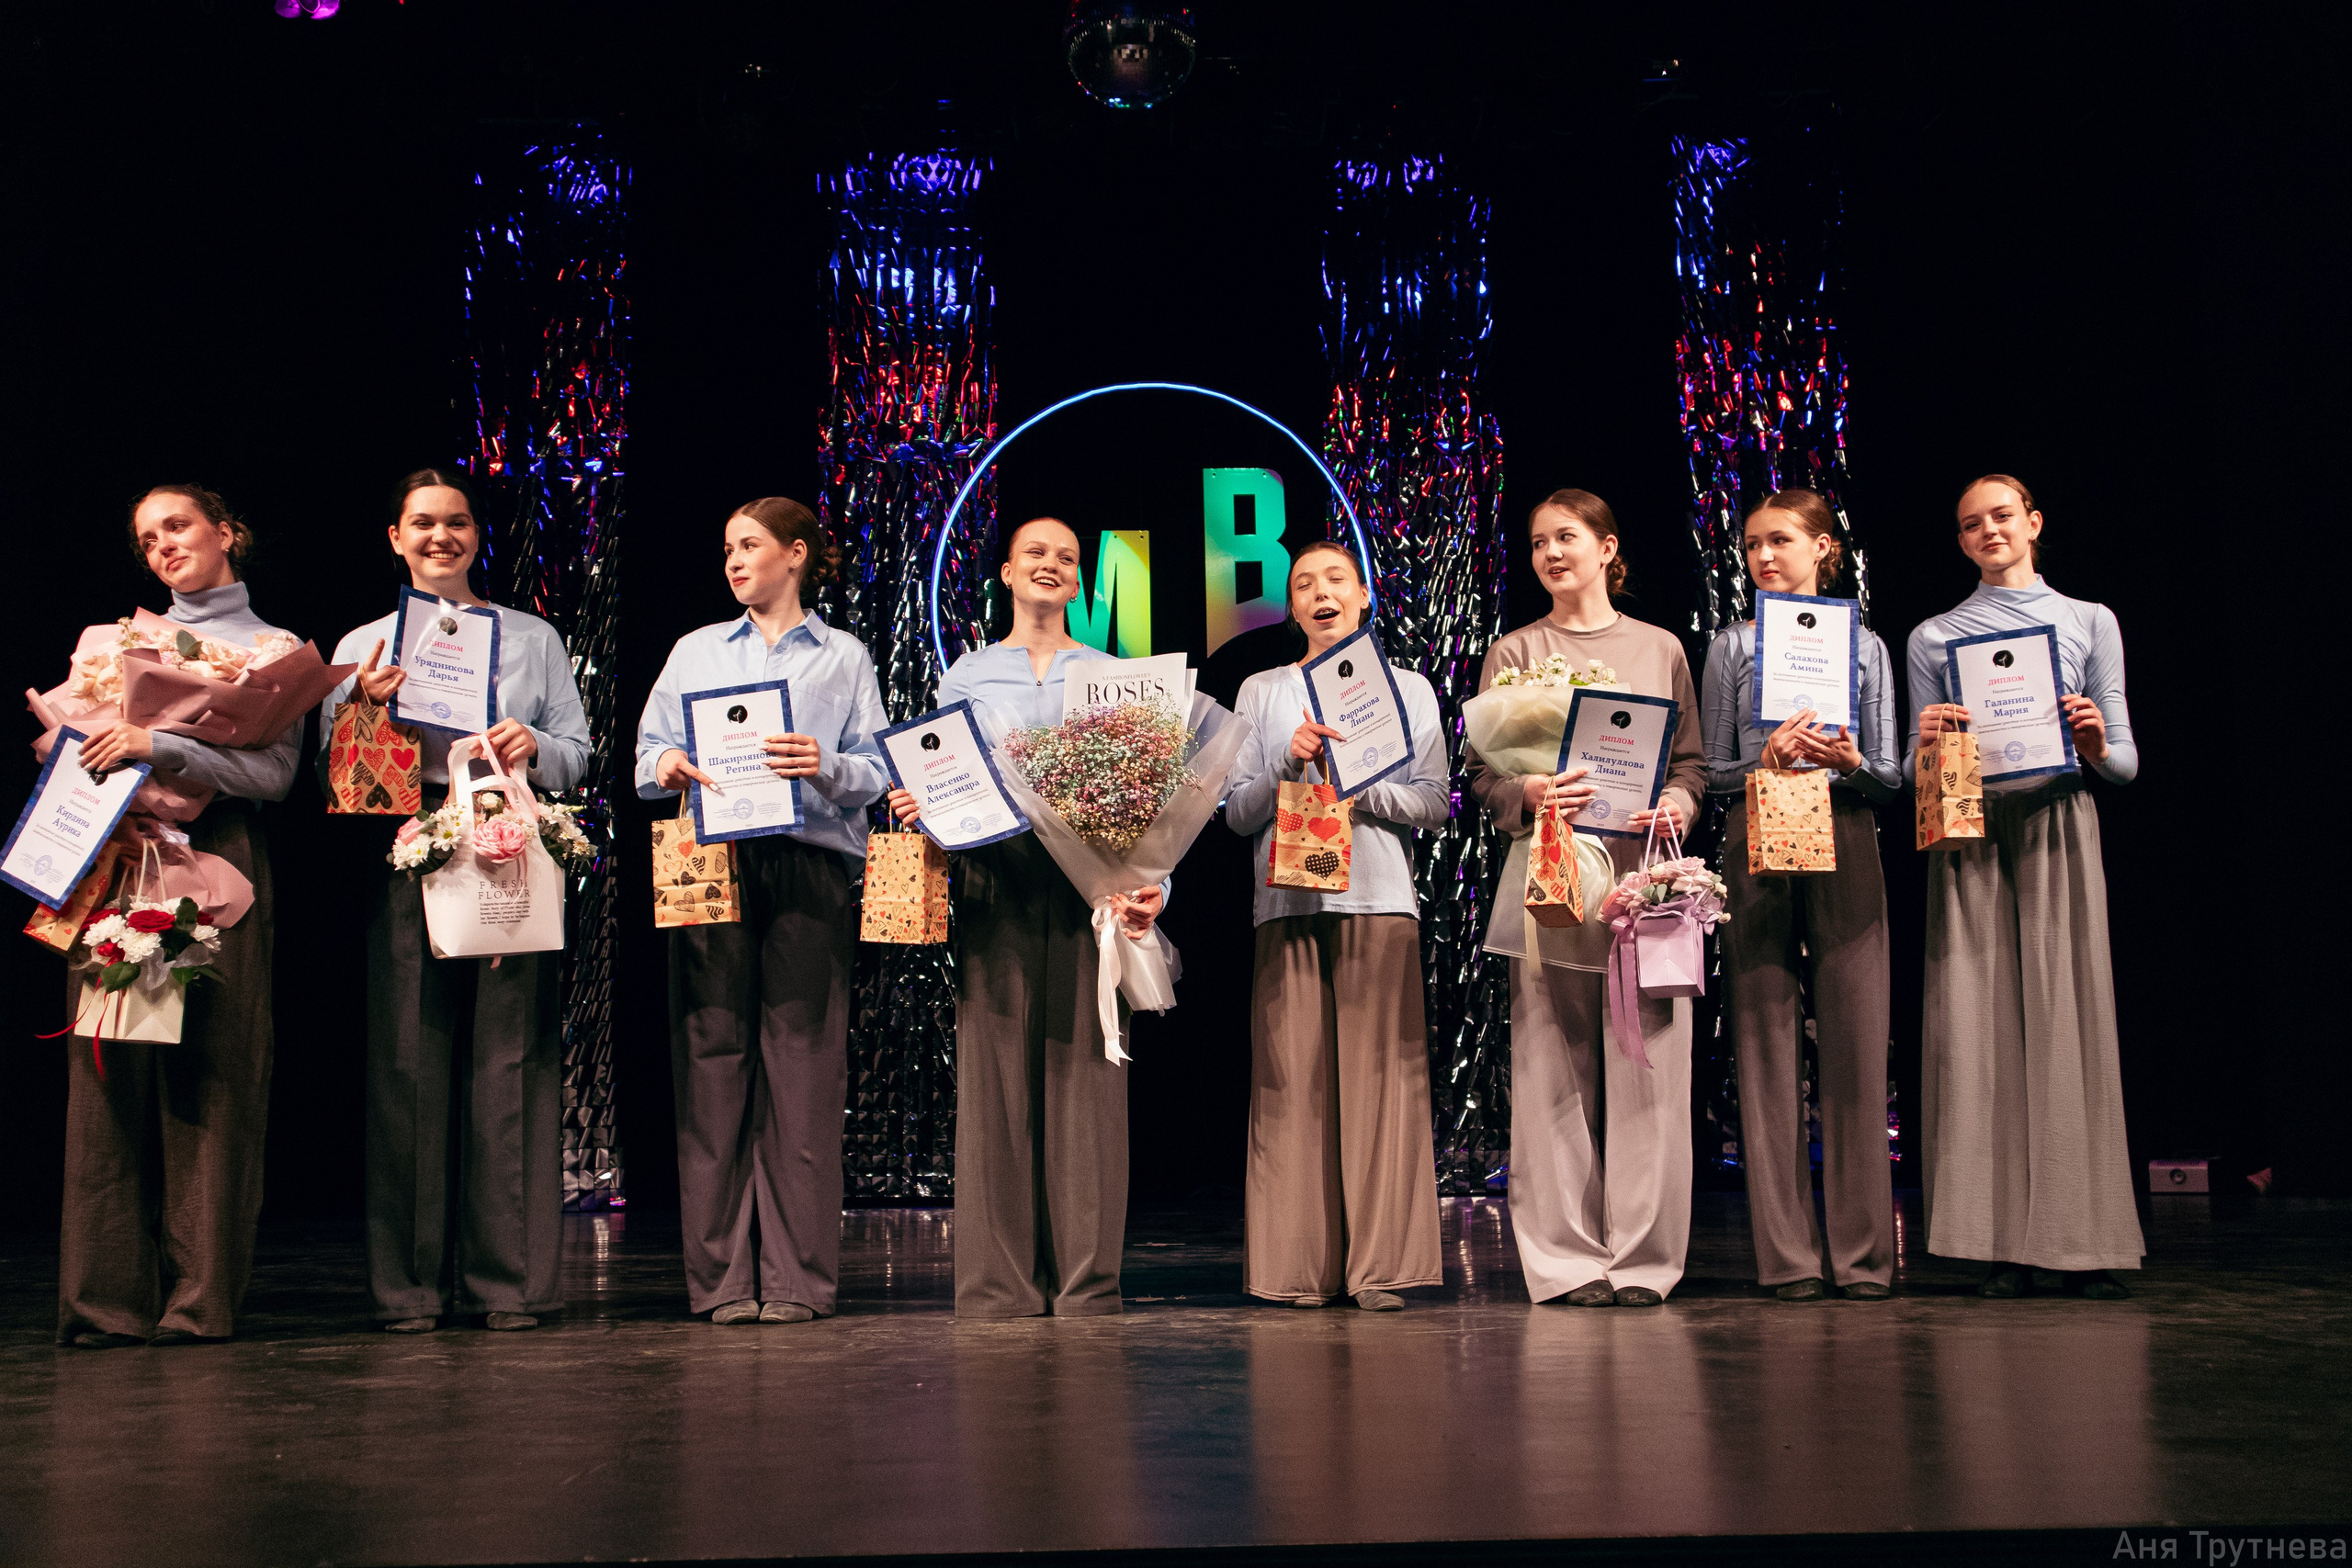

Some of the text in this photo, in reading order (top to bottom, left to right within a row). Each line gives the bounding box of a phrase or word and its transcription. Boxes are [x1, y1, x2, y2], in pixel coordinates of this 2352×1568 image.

[430, 638, 464, 654] ИПЛОМ
[1789, 636, 1824, 644] ДИПЛОМ
[415, 655, 474, 675] Урядникова
[1784, 652, 1828, 664] Салахова
[428, 669, 458, 682] Дарья
[1790, 662, 1823, 673] Амина
[1988, 675, 2025, 686] ДИПЛОМ
[1086, 678, 1166, 705] ROSES
[1340, 680, 1366, 700] ДИПЛОМ
[1339, 696, 1380, 722] Фаррахова
[1984, 696, 2035, 708] Галанина
[1351, 711, 1374, 728] Лиана
[1994, 707, 2029, 717] Мария
[722, 731, 758, 742] ДИПЛОМ
[1599, 735, 1634, 746] ДИПЛОМ
[708, 751, 777, 767] Шакирзянова
[923, 754, 956, 772] ДИПЛОМ
[1580, 751, 1645, 769] Халилуллова
[725, 764, 762, 774] Регина
[1595, 764, 1626, 776] Диана
[926, 773, 970, 794] Власенко
[72, 787, 101, 806] ДИПЛОМ
[927, 780, 980, 805] Александра
[56, 805, 90, 829] Кирдина
[52, 818, 81, 838] Аурика
[480, 879, 528, 889] FRESH
[478, 889, 531, 899] FLOWER
